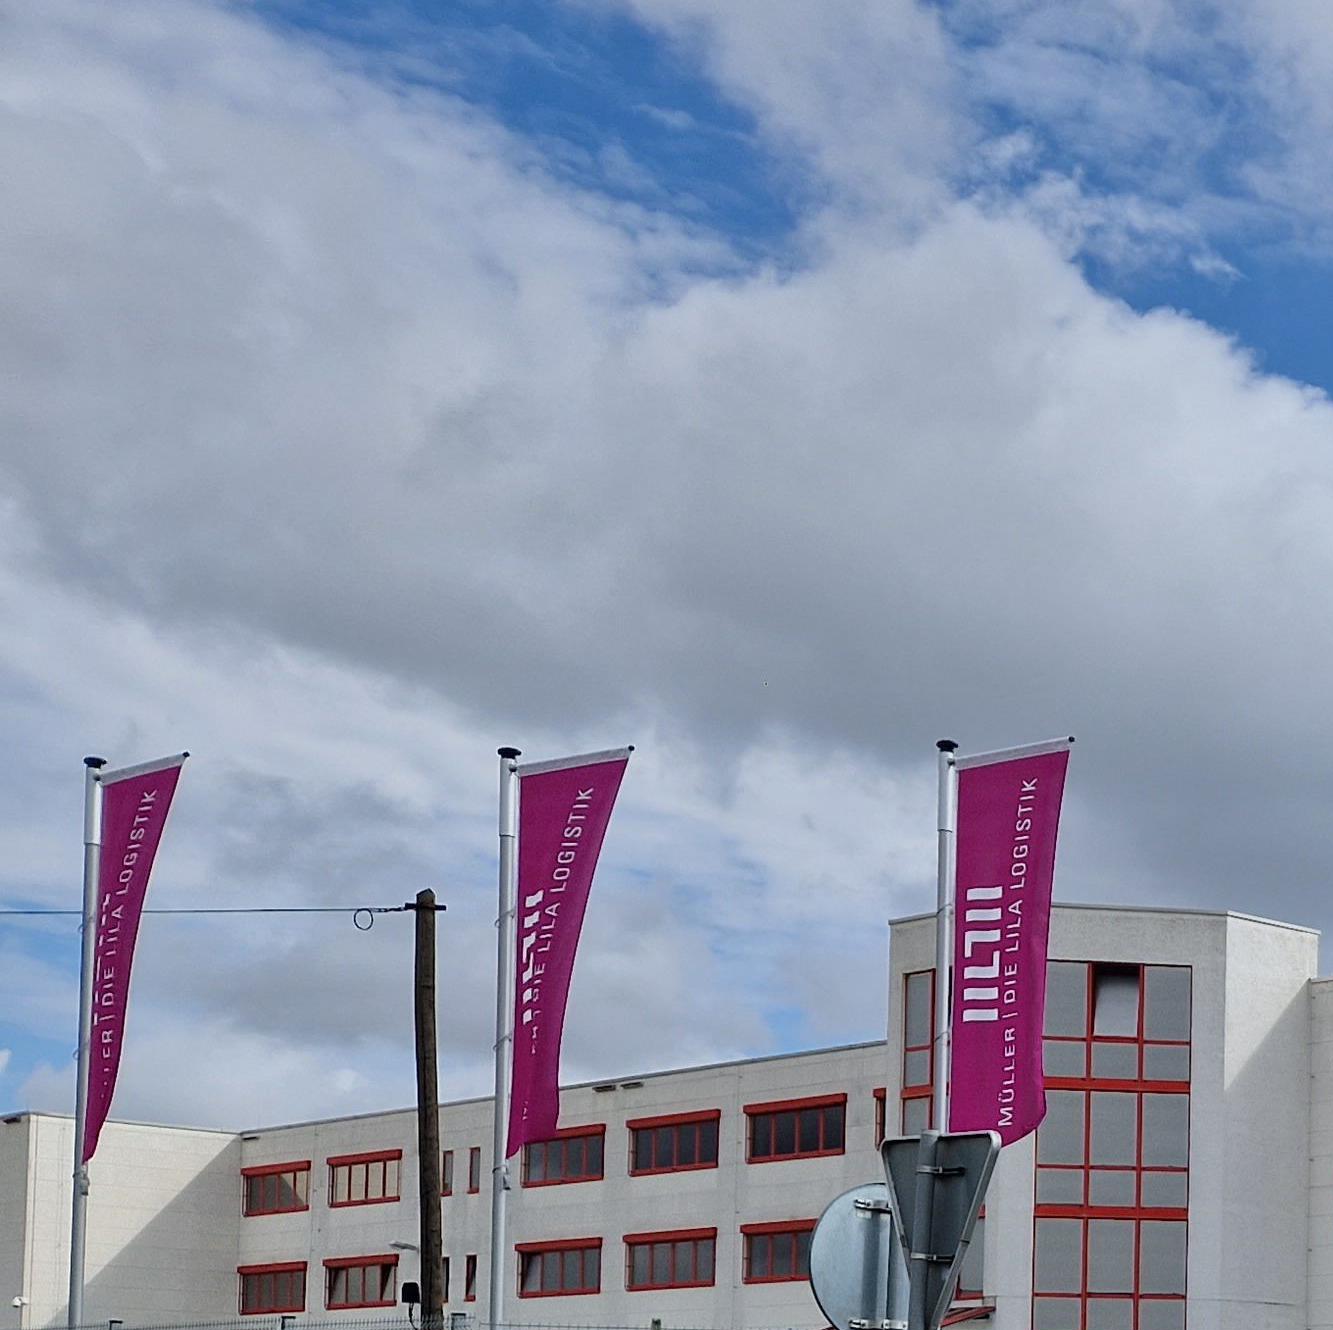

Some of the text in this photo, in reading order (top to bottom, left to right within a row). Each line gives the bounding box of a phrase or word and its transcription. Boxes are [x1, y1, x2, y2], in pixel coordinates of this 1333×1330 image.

[101, 962, 116, 1007] DIE
[115, 787, 160, 898] LOGISTIK
[537, 902, 561, 953] LILA
[550, 786, 595, 894] LOGISTIK
[997, 776, 1040, 1128] MÜLLER DIE LILA LOGISTIK
